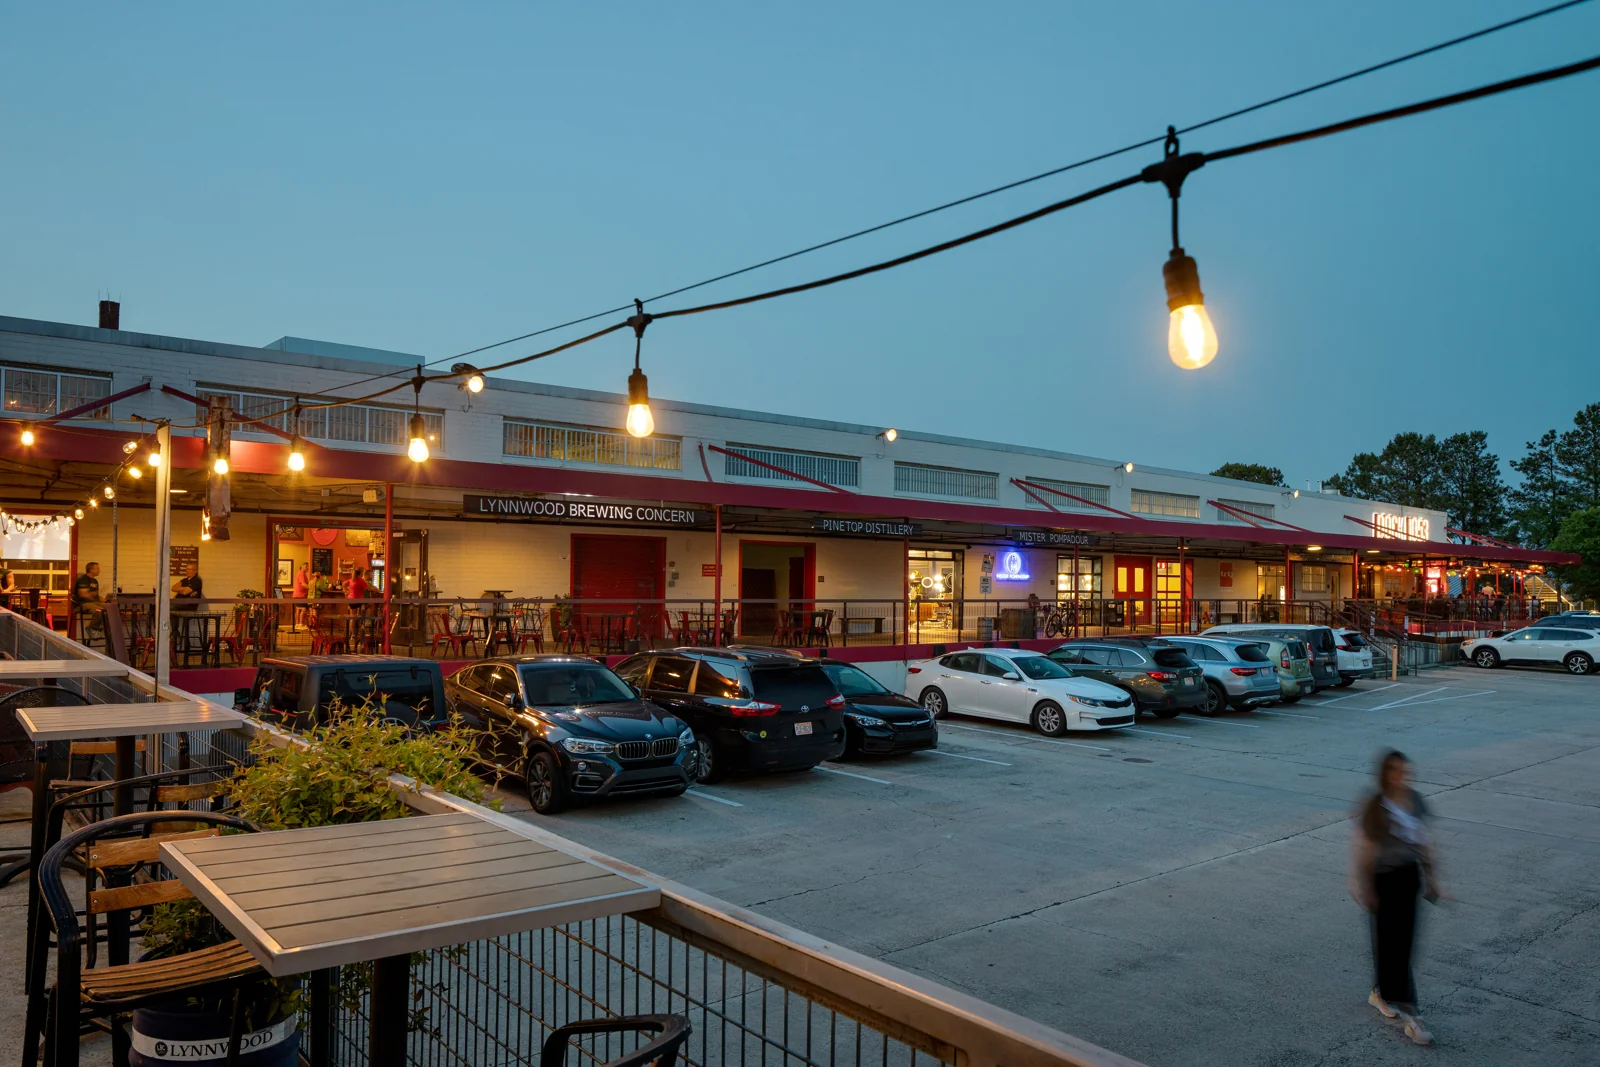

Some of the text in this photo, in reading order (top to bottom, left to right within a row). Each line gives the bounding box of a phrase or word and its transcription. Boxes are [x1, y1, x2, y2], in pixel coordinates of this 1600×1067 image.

[479, 498, 695, 523] LYNNWOOD BREWING CONCERN
[823, 519, 914, 536] PINETOP DISTILLERY
[1019, 531, 1089, 545] MISTER POMPADOUR
